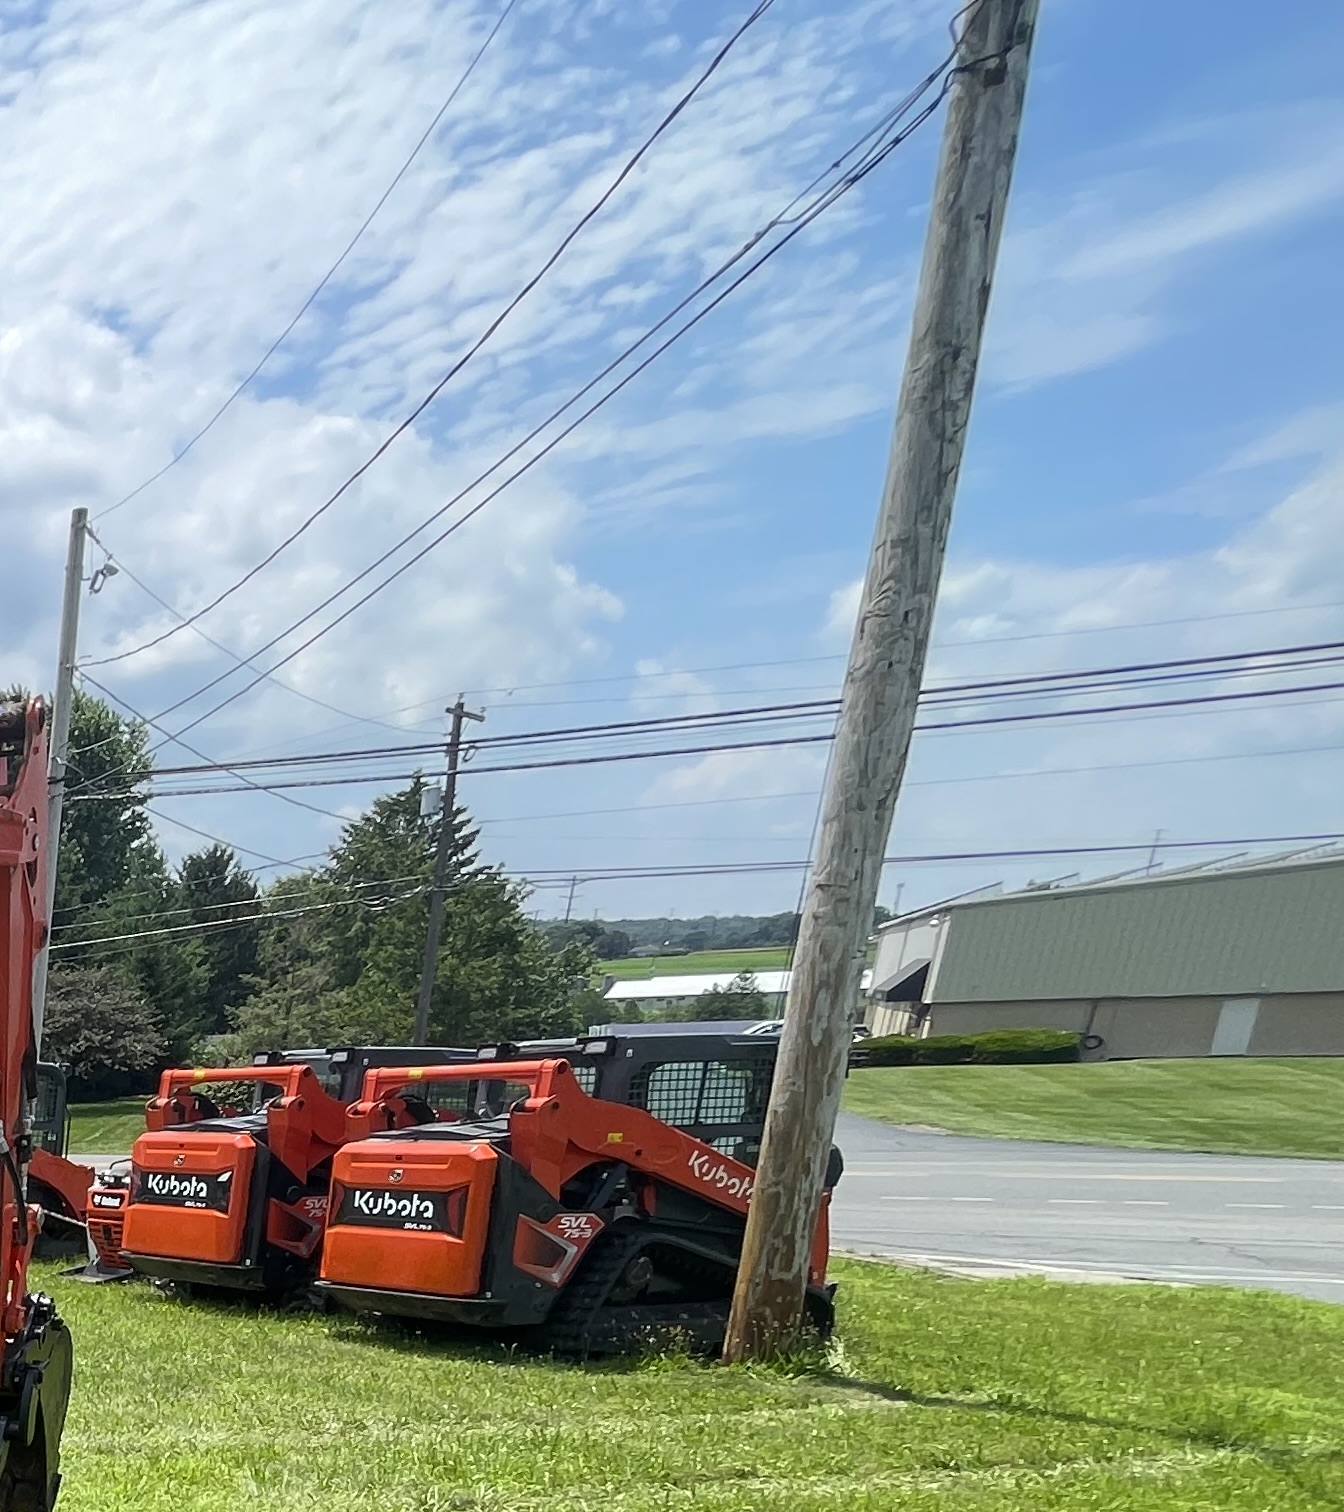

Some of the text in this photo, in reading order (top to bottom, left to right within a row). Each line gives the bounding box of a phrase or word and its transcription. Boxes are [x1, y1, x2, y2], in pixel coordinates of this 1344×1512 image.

[148, 1173, 208, 1198] Kubota
[354, 1190, 434, 1219] Kubota
[558, 1216, 592, 1229] SVL
[563, 1228, 593, 1239] 75-3
